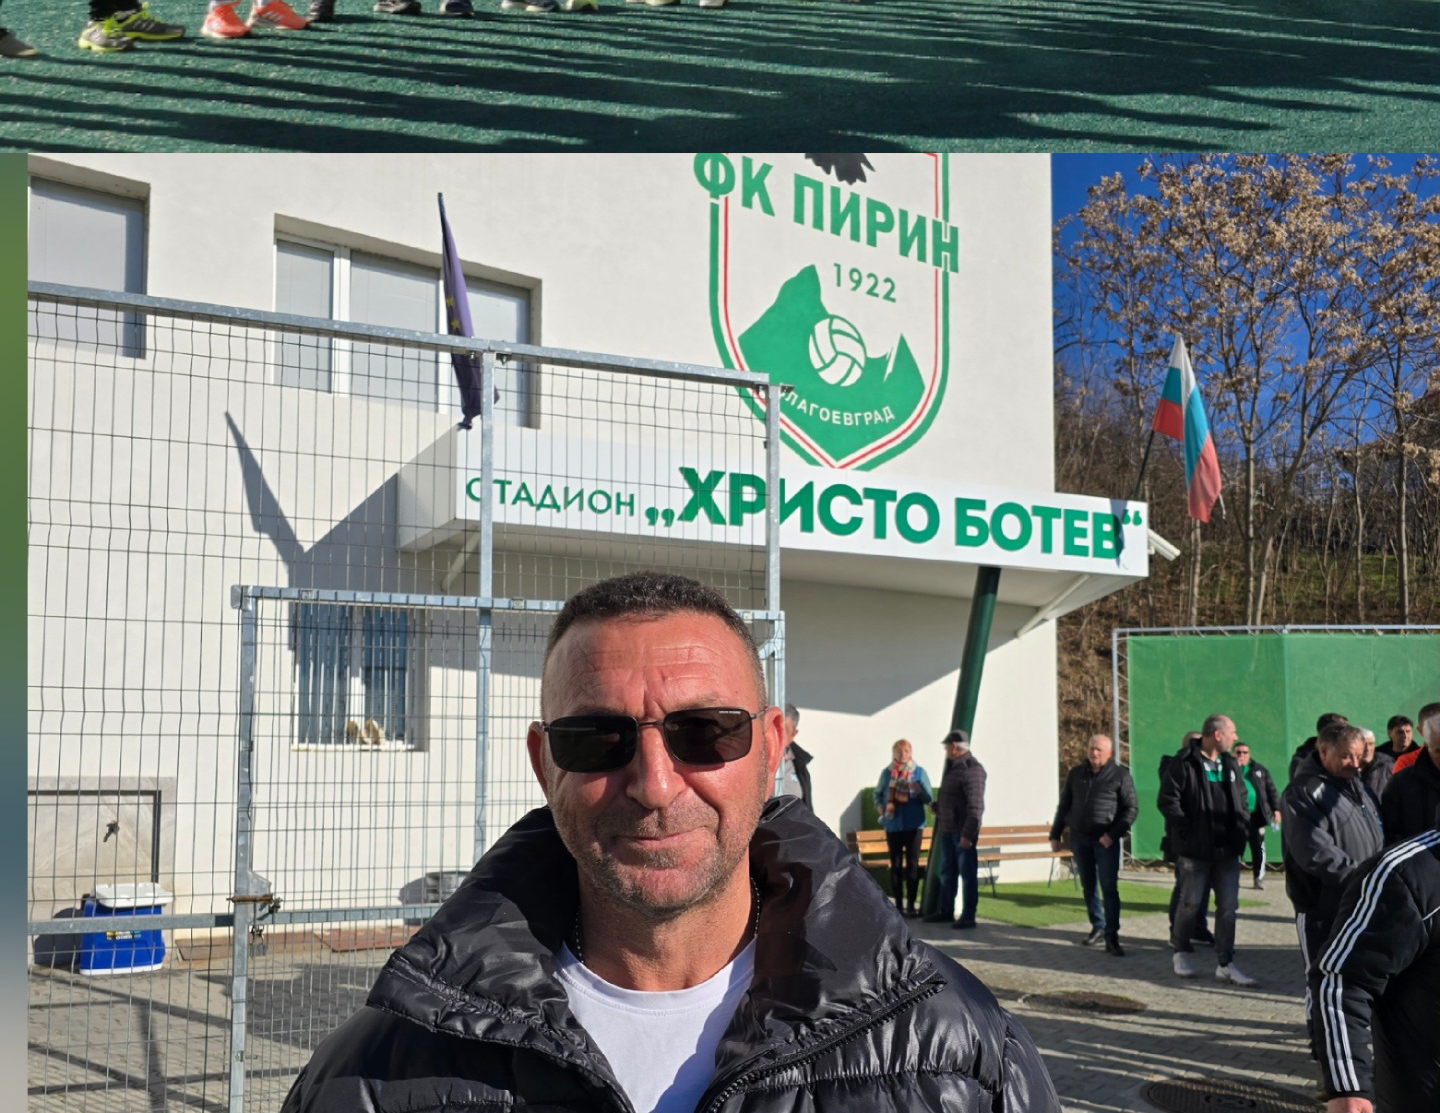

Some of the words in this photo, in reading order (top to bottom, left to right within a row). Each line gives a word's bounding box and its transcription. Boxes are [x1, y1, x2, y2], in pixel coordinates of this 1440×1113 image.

[693, 153, 776, 218] ФК
[793, 172, 960, 274] ПИРИН
[833, 262, 898, 304] 1922
[778, 387, 896, 427] ЛАГОЕВГРАД
[465, 476, 636, 518] СТАДИОН
